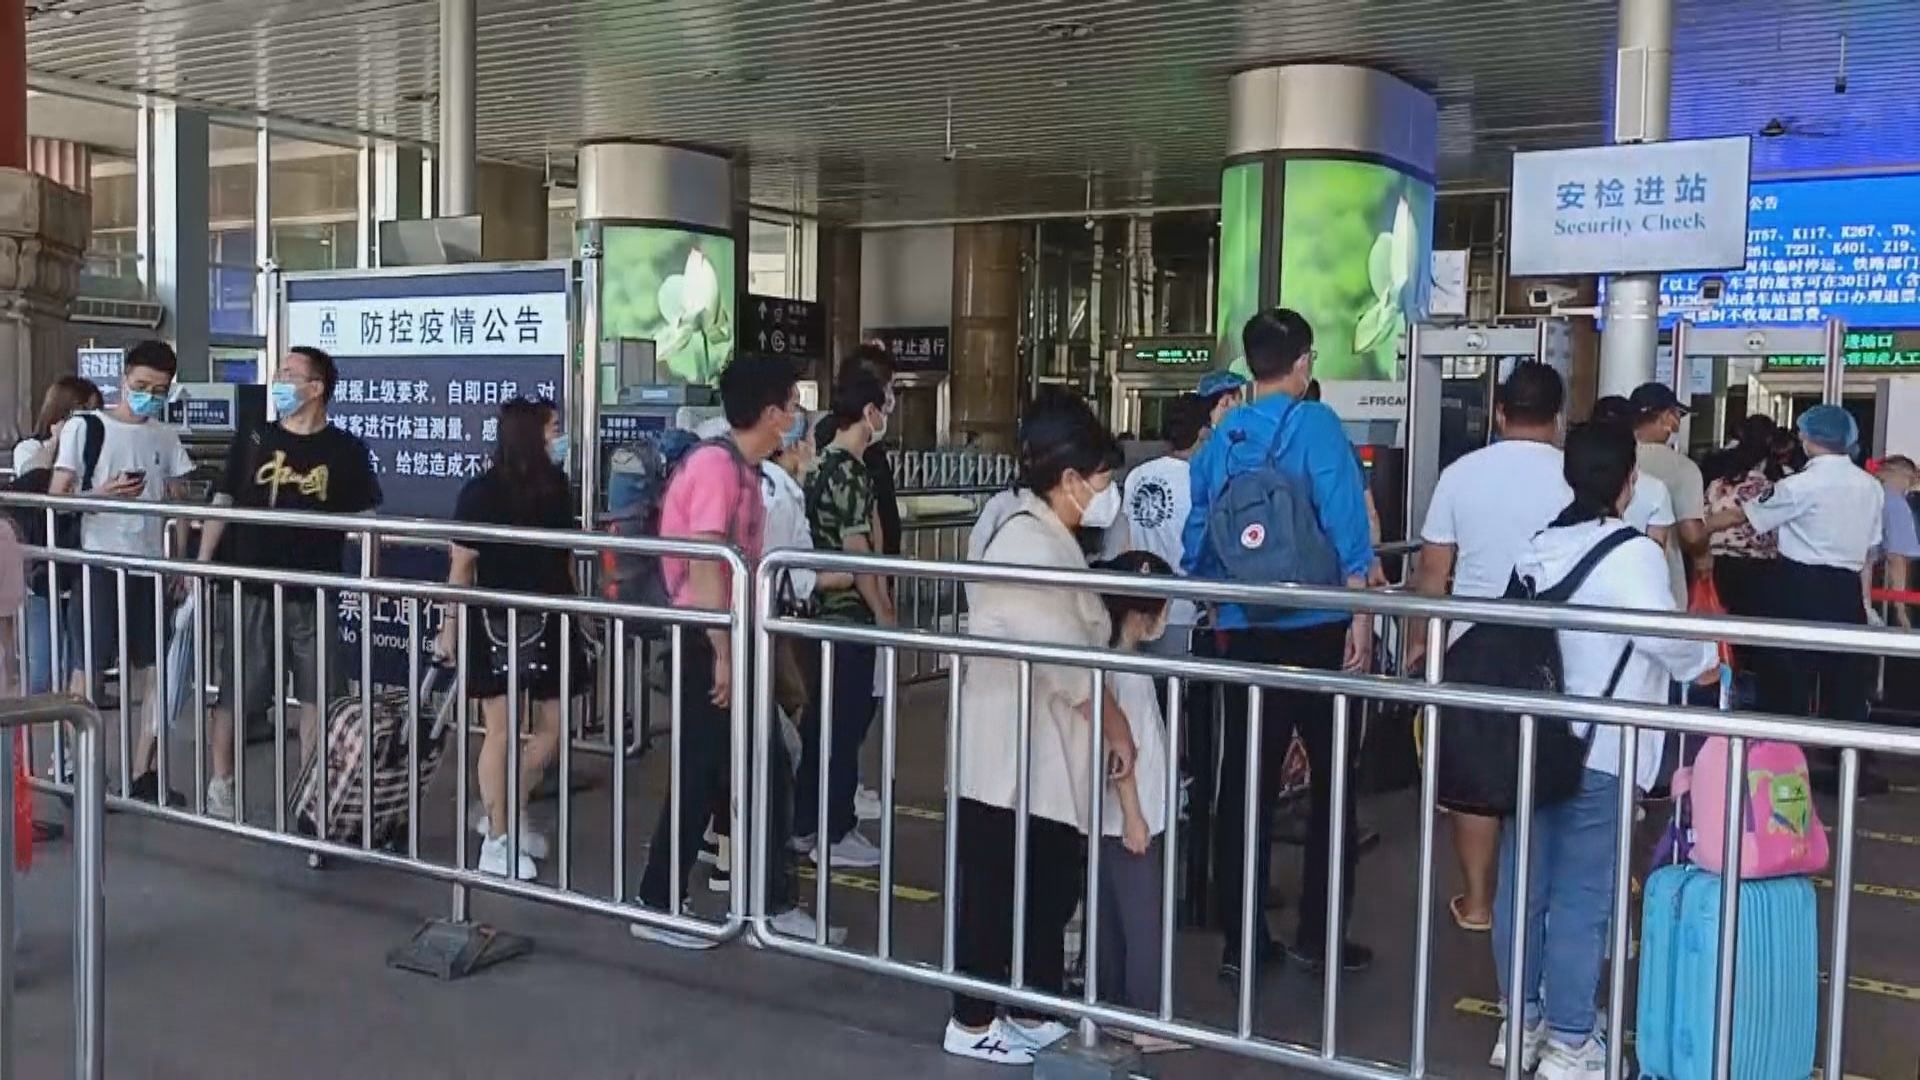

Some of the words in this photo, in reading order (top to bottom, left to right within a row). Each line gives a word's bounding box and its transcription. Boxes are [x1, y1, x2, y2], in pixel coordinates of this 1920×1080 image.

[1556, 173, 1707, 211] 安检进站
[1554, 215, 1632, 237] Security
[1641, 211, 1706, 233] Check
[360, 304, 543, 346] 防控疫情公告
[338, 626, 357, 643] No
